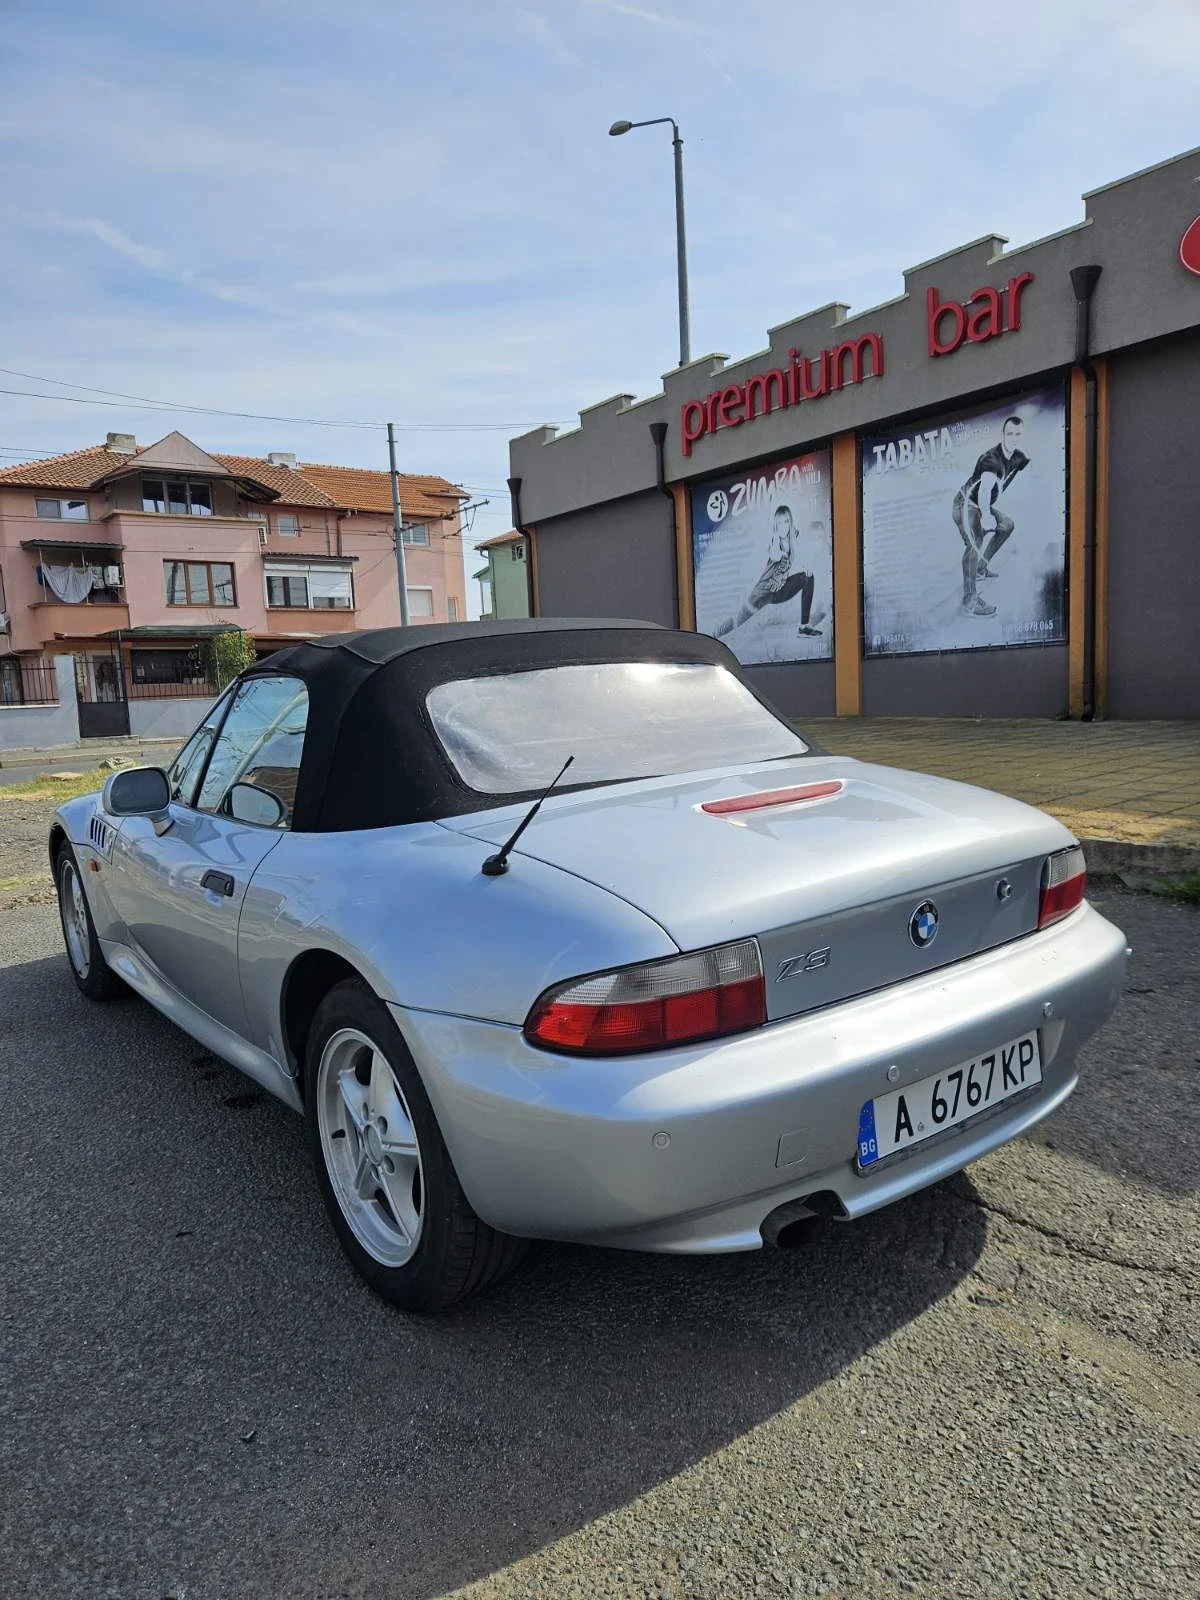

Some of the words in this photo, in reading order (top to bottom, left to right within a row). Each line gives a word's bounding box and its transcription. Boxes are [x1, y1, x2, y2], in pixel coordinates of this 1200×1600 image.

[681, 332, 884, 457] premium
[926, 271, 1035, 358] bar
[872, 427, 954, 474] TABATA
[729, 464, 804, 517] ZUMBA
[775, 946, 832, 983] Z3
[894, 1094, 915, 1144] A
[860, 1138, 876, 1156] BG
